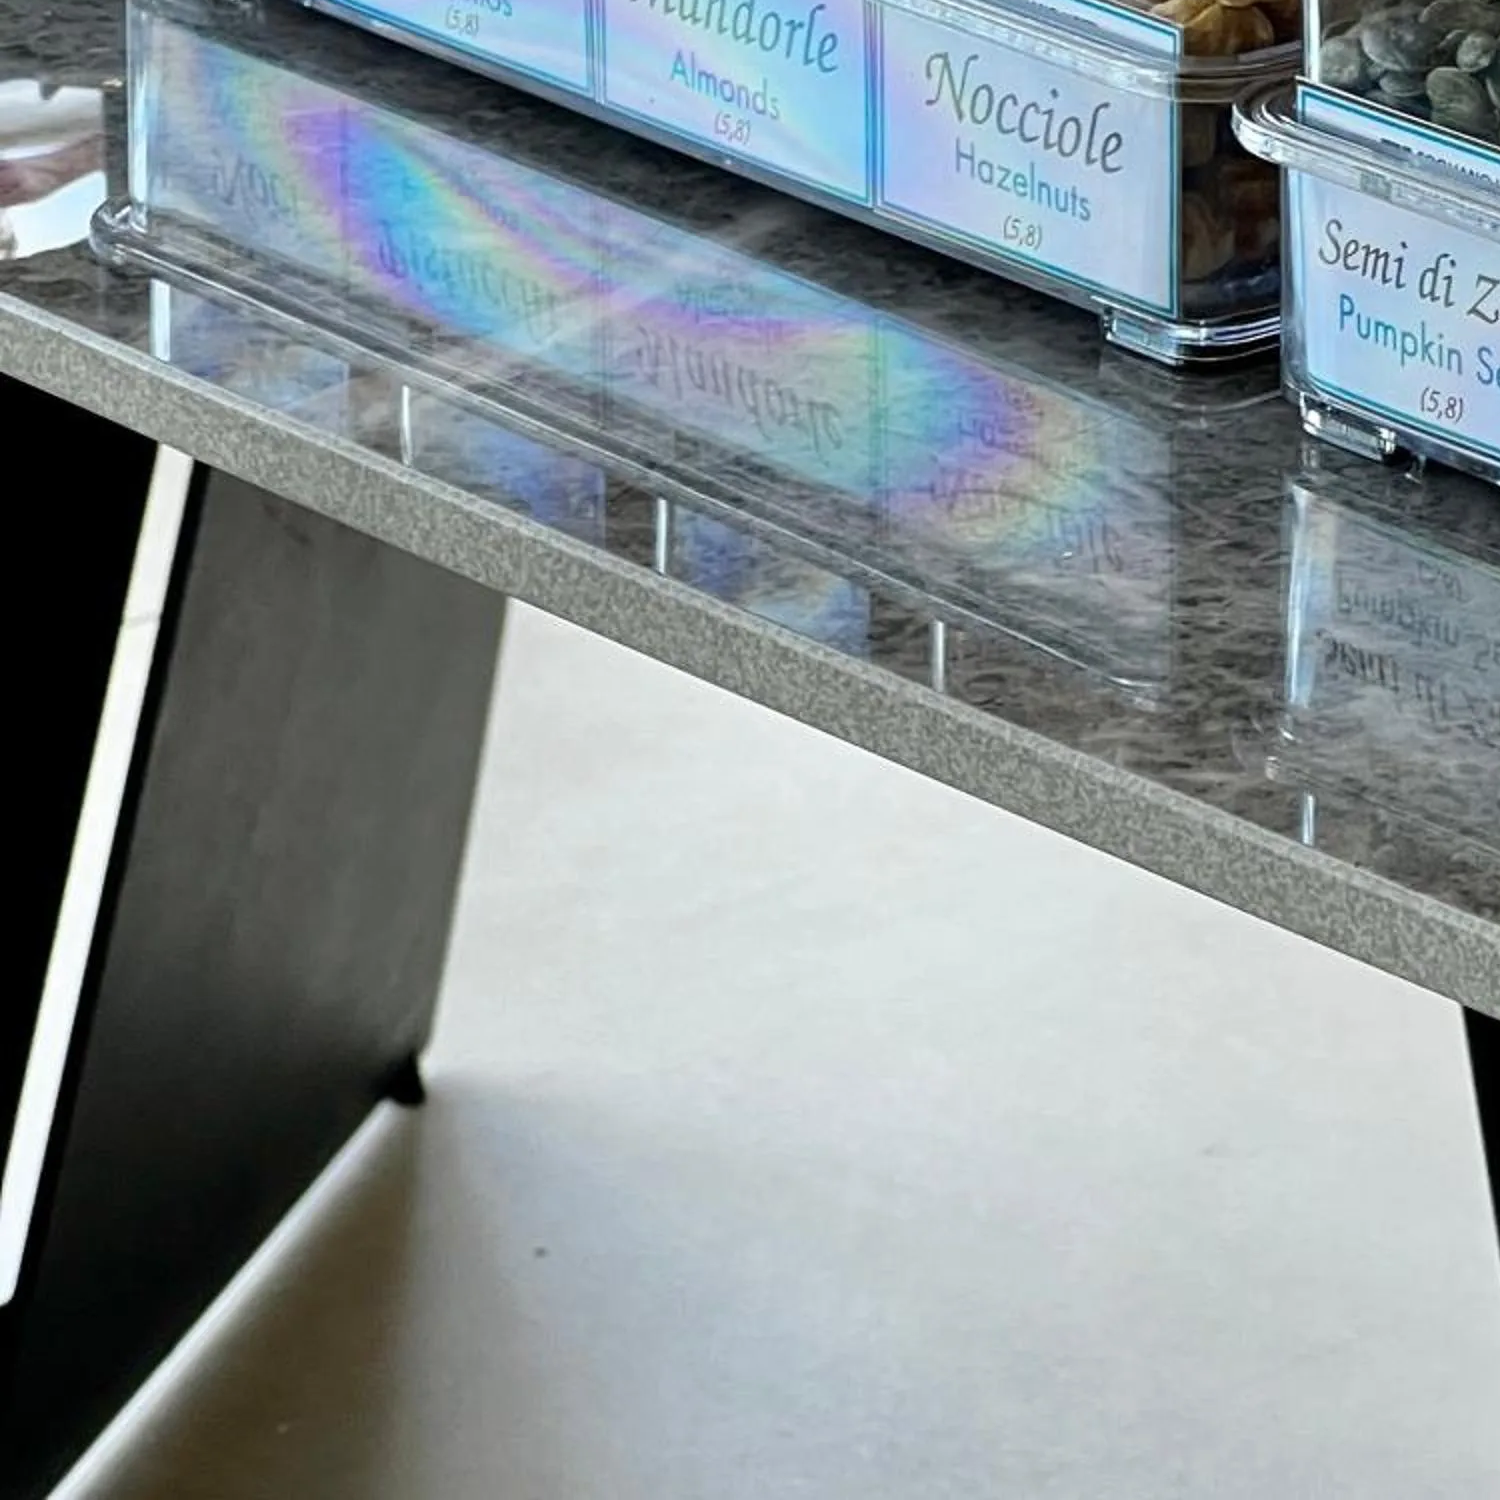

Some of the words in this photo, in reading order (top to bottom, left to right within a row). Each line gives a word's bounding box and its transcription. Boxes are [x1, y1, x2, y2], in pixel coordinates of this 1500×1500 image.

[670, 50, 780, 121] Almonds
[925, 51, 1123, 174] Nocciole
[714, 111, 751, 146] (5,8)
[955, 138, 1092, 222] Hazelnuts
[1003, 215, 1043, 250] (5,8)
[1318, 219, 1408, 290] Semi
[1419, 252, 1457, 308] di
[1338, 294, 1464, 375] Pumpkin
[1420, 386, 1464, 424] (5,8)
